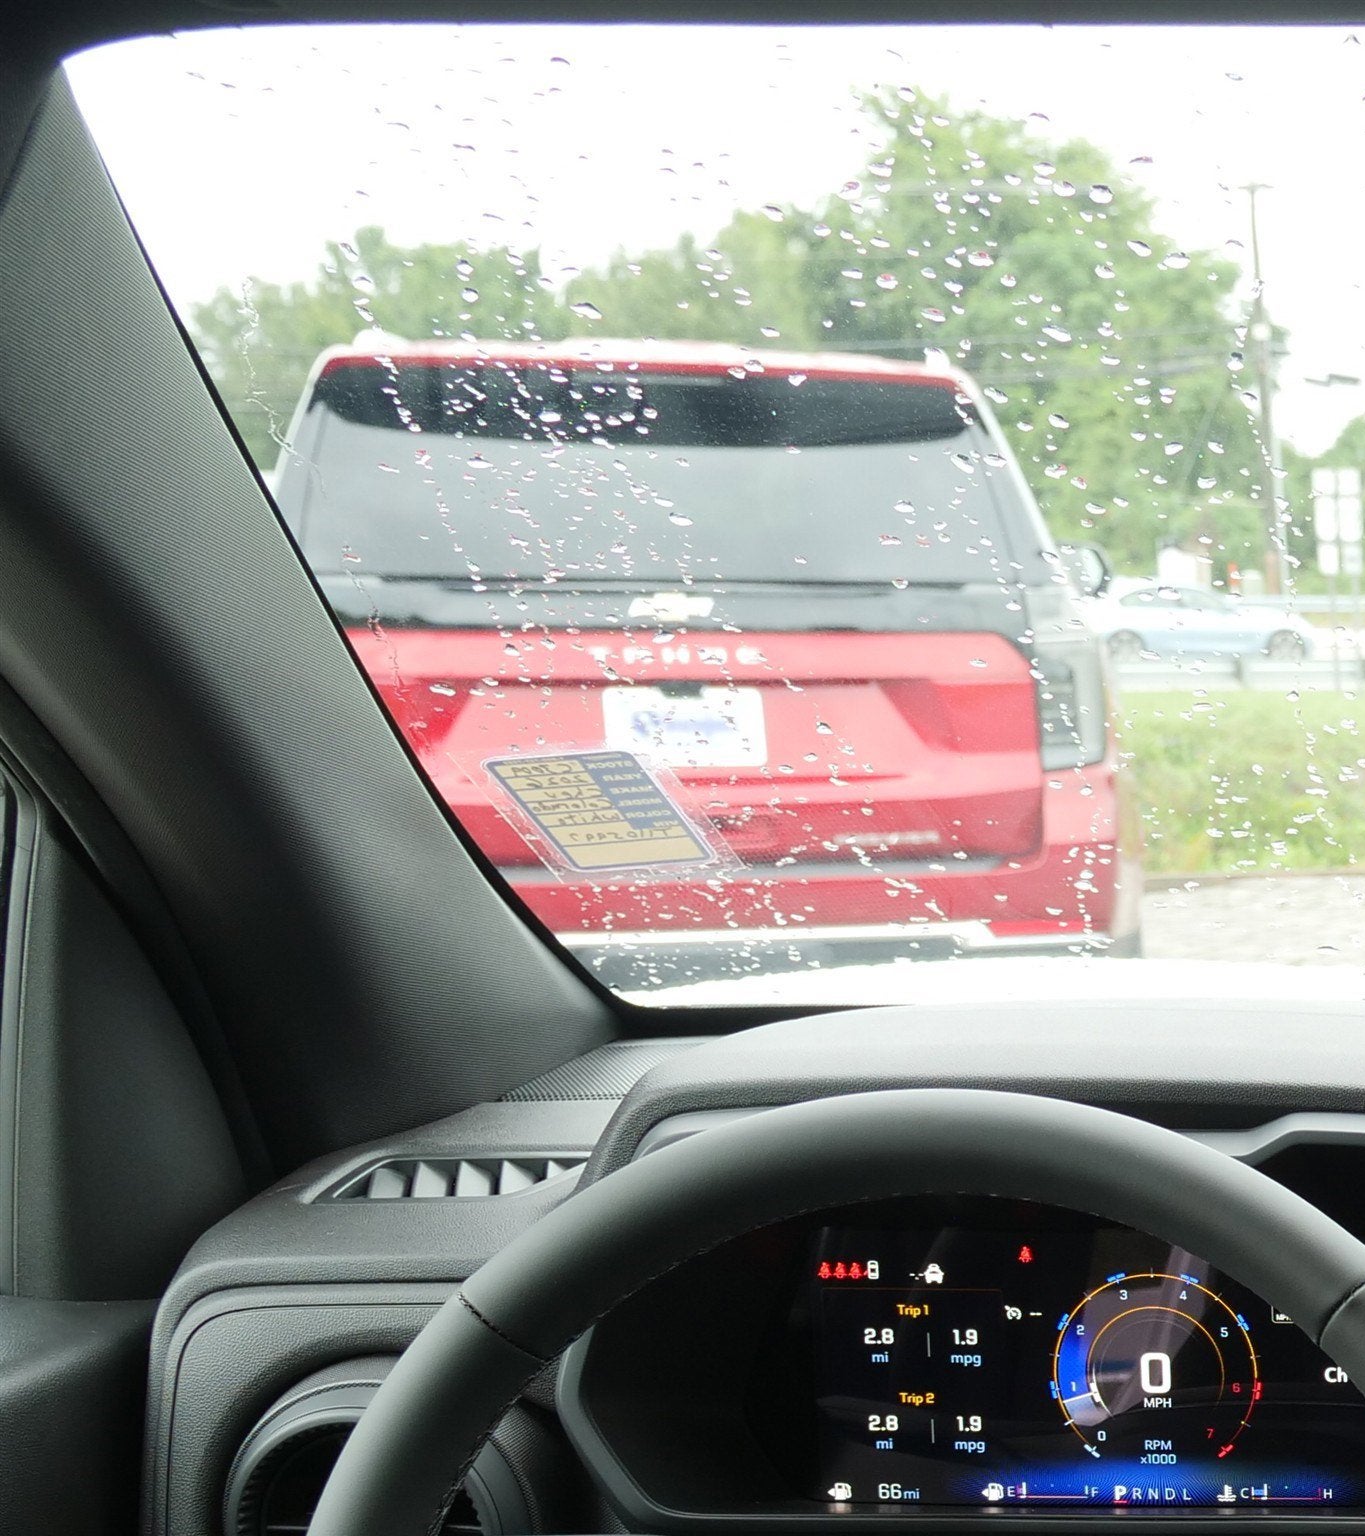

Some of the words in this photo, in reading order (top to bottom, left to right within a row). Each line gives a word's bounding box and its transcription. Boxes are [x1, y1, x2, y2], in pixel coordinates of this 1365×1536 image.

[1120, 1290, 1128, 1300] 3
[1179, 1290, 1187, 1300] 4
[897, 1304, 921, 1318] Trip
[923, 1304, 929, 1315] 1
[1076, 1325, 1084, 1335] 2
[1220, 1327, 1229, 1337] 5
[864, 1328, 894, 1344] 2.8
[952, 1329, 978, 1345] 1.9
[872, 1352, 889, 1363] mi
[951, 1354, 981, 1367] mpg
[1140, 1353, 1171, 1394] 0
[1071, 1382, 1076, 1391] 1
[1232, 1383, 1241, 1393] 6
[899, 1392, 924, 1406] Trip
[926, 1393, 935, 1404] 2
[1144, 1398, 1172, 1408] MPH
[868, 1415, 899, 1431] 2.8
[956, 1416, 982, 1432] 1.9
[1098, 1431, 1106, 1441] 0
[1206, 1429, 1214, 1439] 7
[876, 1438, 893, 1449] mi
[955, 1440, 985, 1453] mpg
[1145, 1441, 1172, 1450] RPM
[1140, 1454, 1176, 1465] x1000
[878, 1483, 901, 1499] 66
[904, 1488, 919, 1499] mi
[1007, 1486, 1015, 1497] E
[1092, 1488, 1099, 1497] F
[1114, 1486, 1126, 1500] P
[1133, 1489, 1142, 1499] R
[1149, 1489, 1159, 1499] N
[1166, 1489, 1175, 1499] D
[1183, 1490, 1191, 1500] L
[1241, 1488, 1249, 1498] C
[1323, 1489, 1332, 1499] H
